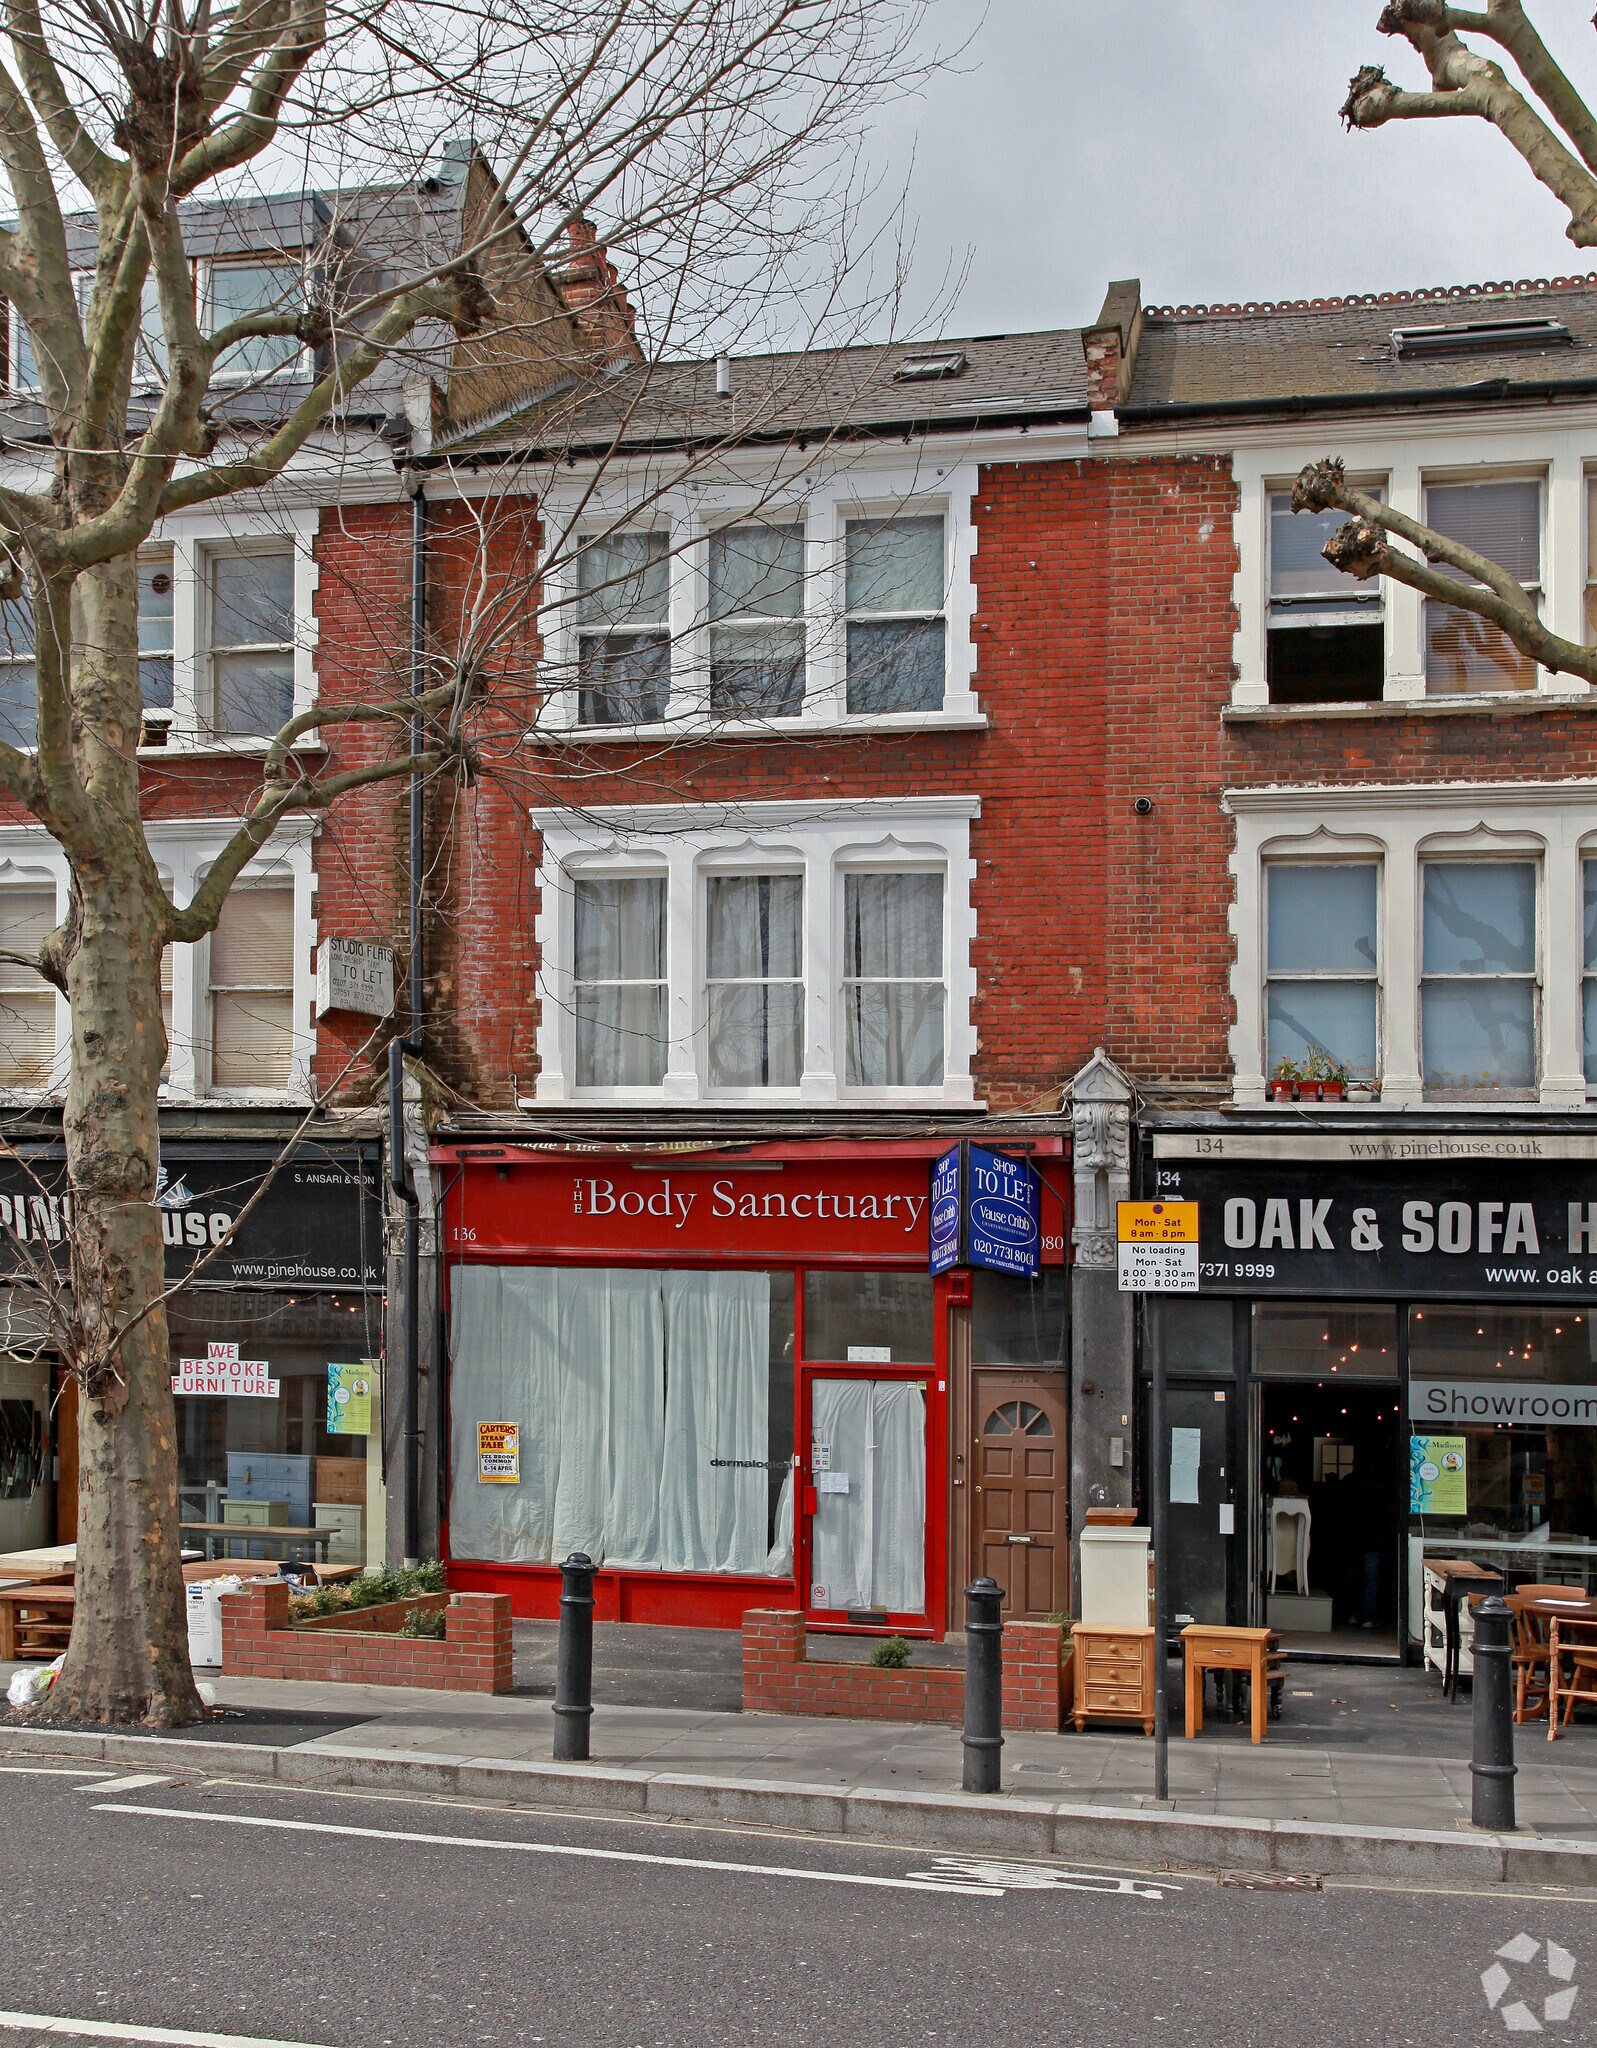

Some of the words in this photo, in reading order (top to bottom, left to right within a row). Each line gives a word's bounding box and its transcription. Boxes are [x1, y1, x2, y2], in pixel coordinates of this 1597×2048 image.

[331, 938, 364, 956] STUDIO
[367, 945, 394, 962] FLATS
[342, 964, 357, 979] TO
[363, 969, 384, 984] LET
[333, 978, 346, 987] 0207
[349, 981, 359, 989] 371
[1194, 1138, 1225, 1154] 134
[1349, 1140, 1543, 1157] www.pinehouse.co.uk
[938, 1158, 949, 1176] SHOP
[993, 1158, 1017, 1176] SHOP
[294, 1174, 303, 1183] S.
[306, 1174, 342, 1184] ANSARI
[344, 1176, 351, 1184] &
[353, 1175, 375, 1185] SON
[931, 1179, 941, 1202] TO
[942, 1167, 957, 1196] LET
[975, 1167, 998, 1193] TO
[1004, 1176, 1034, 1204] LET
[1156, 1171, 1181, 1187] 134
[585, 1179, 698, 1229] Body
[712, 1180, 928, 1232] Sanctuary
[980, 1205, 1007, 1224] Vause
[1008, 1213, 1030, 1231] Cribb
[1135, 1219, 1156, 1227] Mon
[1164, 1219, 1181, 1227] Sat
[1223, 1197, 1335, 1251] OAK
[1350, 1207, 1385, 1252] &
[1402, 1200, 1540, 1254] SOFA
[452, 1228, 477, 1242] 136
[1131, 1230, 1137, 1238] 8
[1162, 1230, 1168, 1238] 8
[1170, 1231, 1185, 1239] pm
[1041, 1236, 1064, 1250] 80
[1132, 1247, 1146, 1255] No
[1150, 1246, 1186, 1256] loading
[974, 1238, 992, 1255] 020
[993, 1244, 1013, 1260] 7731
[1014, 1252, 1034, 1266] 8001
[1122, 1269, 1147, 1278] 8.00
[1154, 1269, 1178, 1278] 9.30
[1234, 1263, 1275, 1278] 9999
[1485, 1268, 1540, 1283] www.
[1546, 1266, 1583, 1284] oak
[1122, 1279, 1146, 1287] 4.30
[1154, 1279, 1179, 1287] 8.00
[209, 1344, 235, 1358] WE
[183, 1361, 265, 1377] BESPOKE
[1426, 1388, 1597, 1418] Showroom
[480, 1424, 516, 1435] CARTERS
[481, 1441, 504, 1449] FAIR
[710, 1458, 793, 1470] dermalogica
